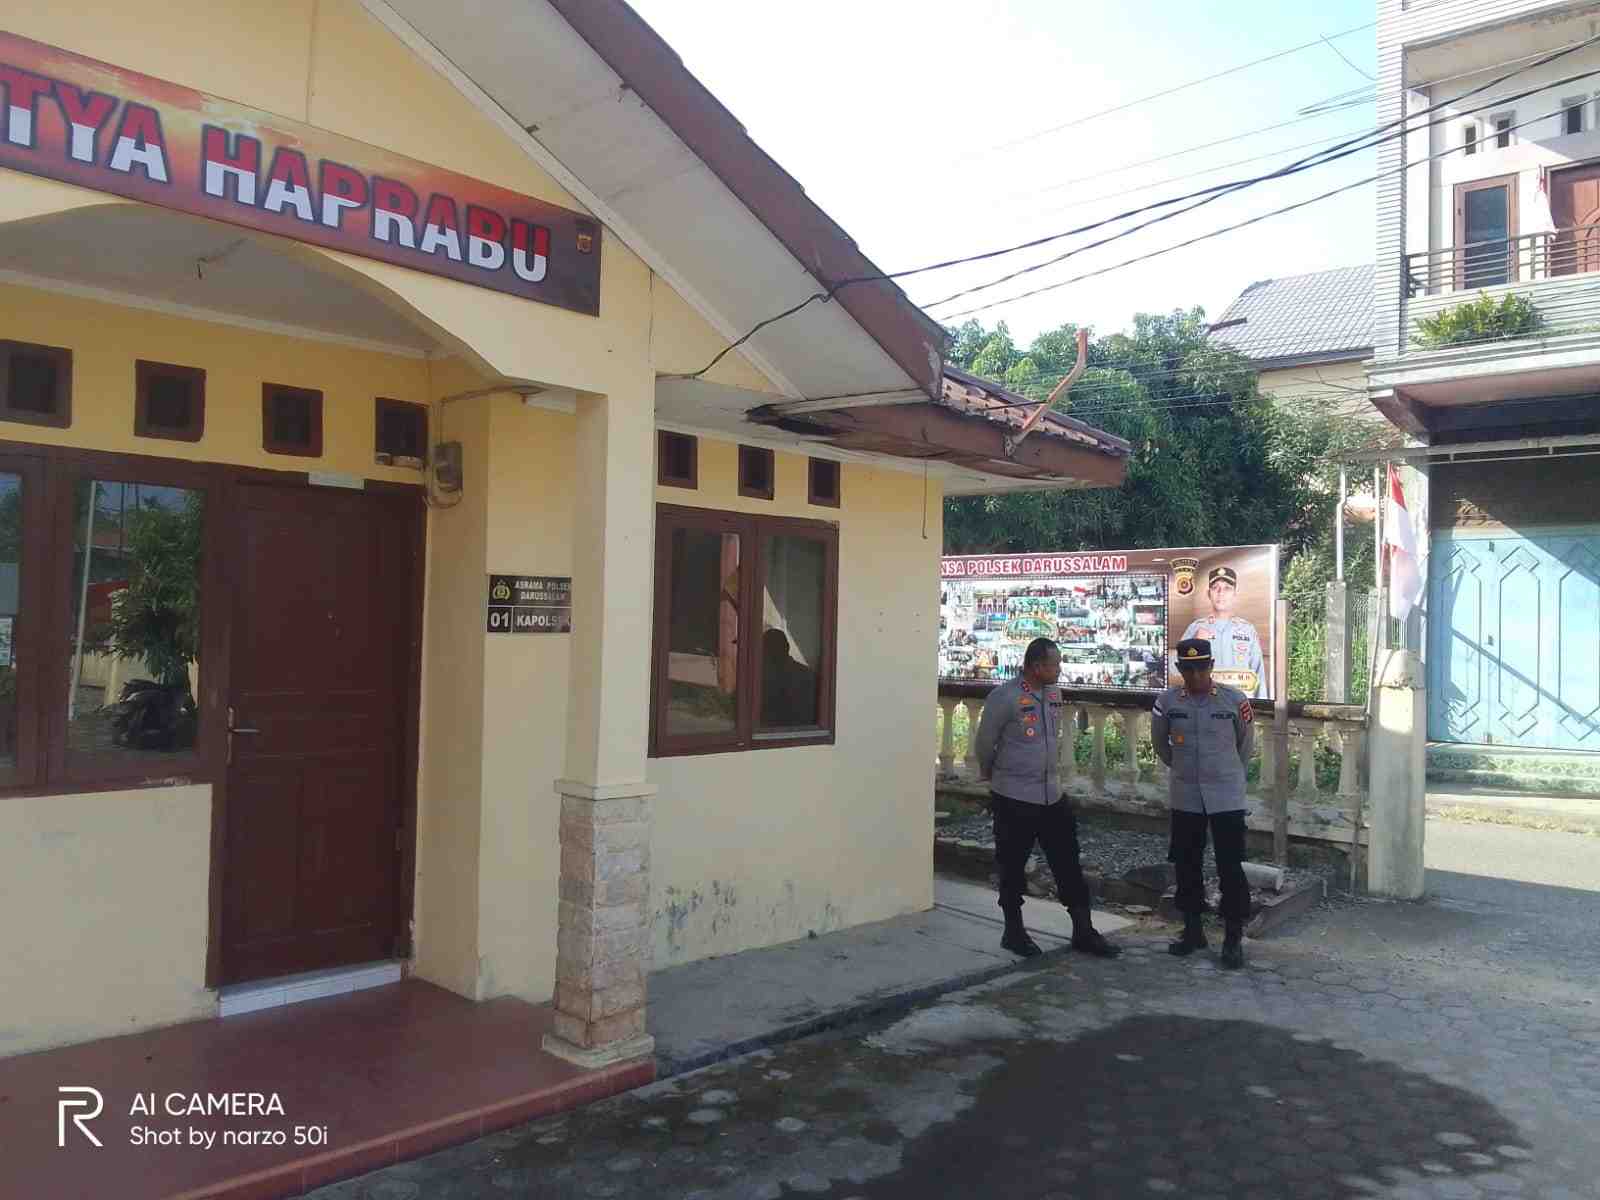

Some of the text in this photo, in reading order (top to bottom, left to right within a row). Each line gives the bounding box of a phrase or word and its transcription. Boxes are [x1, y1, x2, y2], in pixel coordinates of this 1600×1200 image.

[204, 125, 551, 284] HAPRABU
[967, 559, 1021, 575] POLSEK
[1023, 555, 1127, 574] DARUSSALAM
[514, 580, 544, 589] ASRAMA
[490, 612, 509, 627] 01
